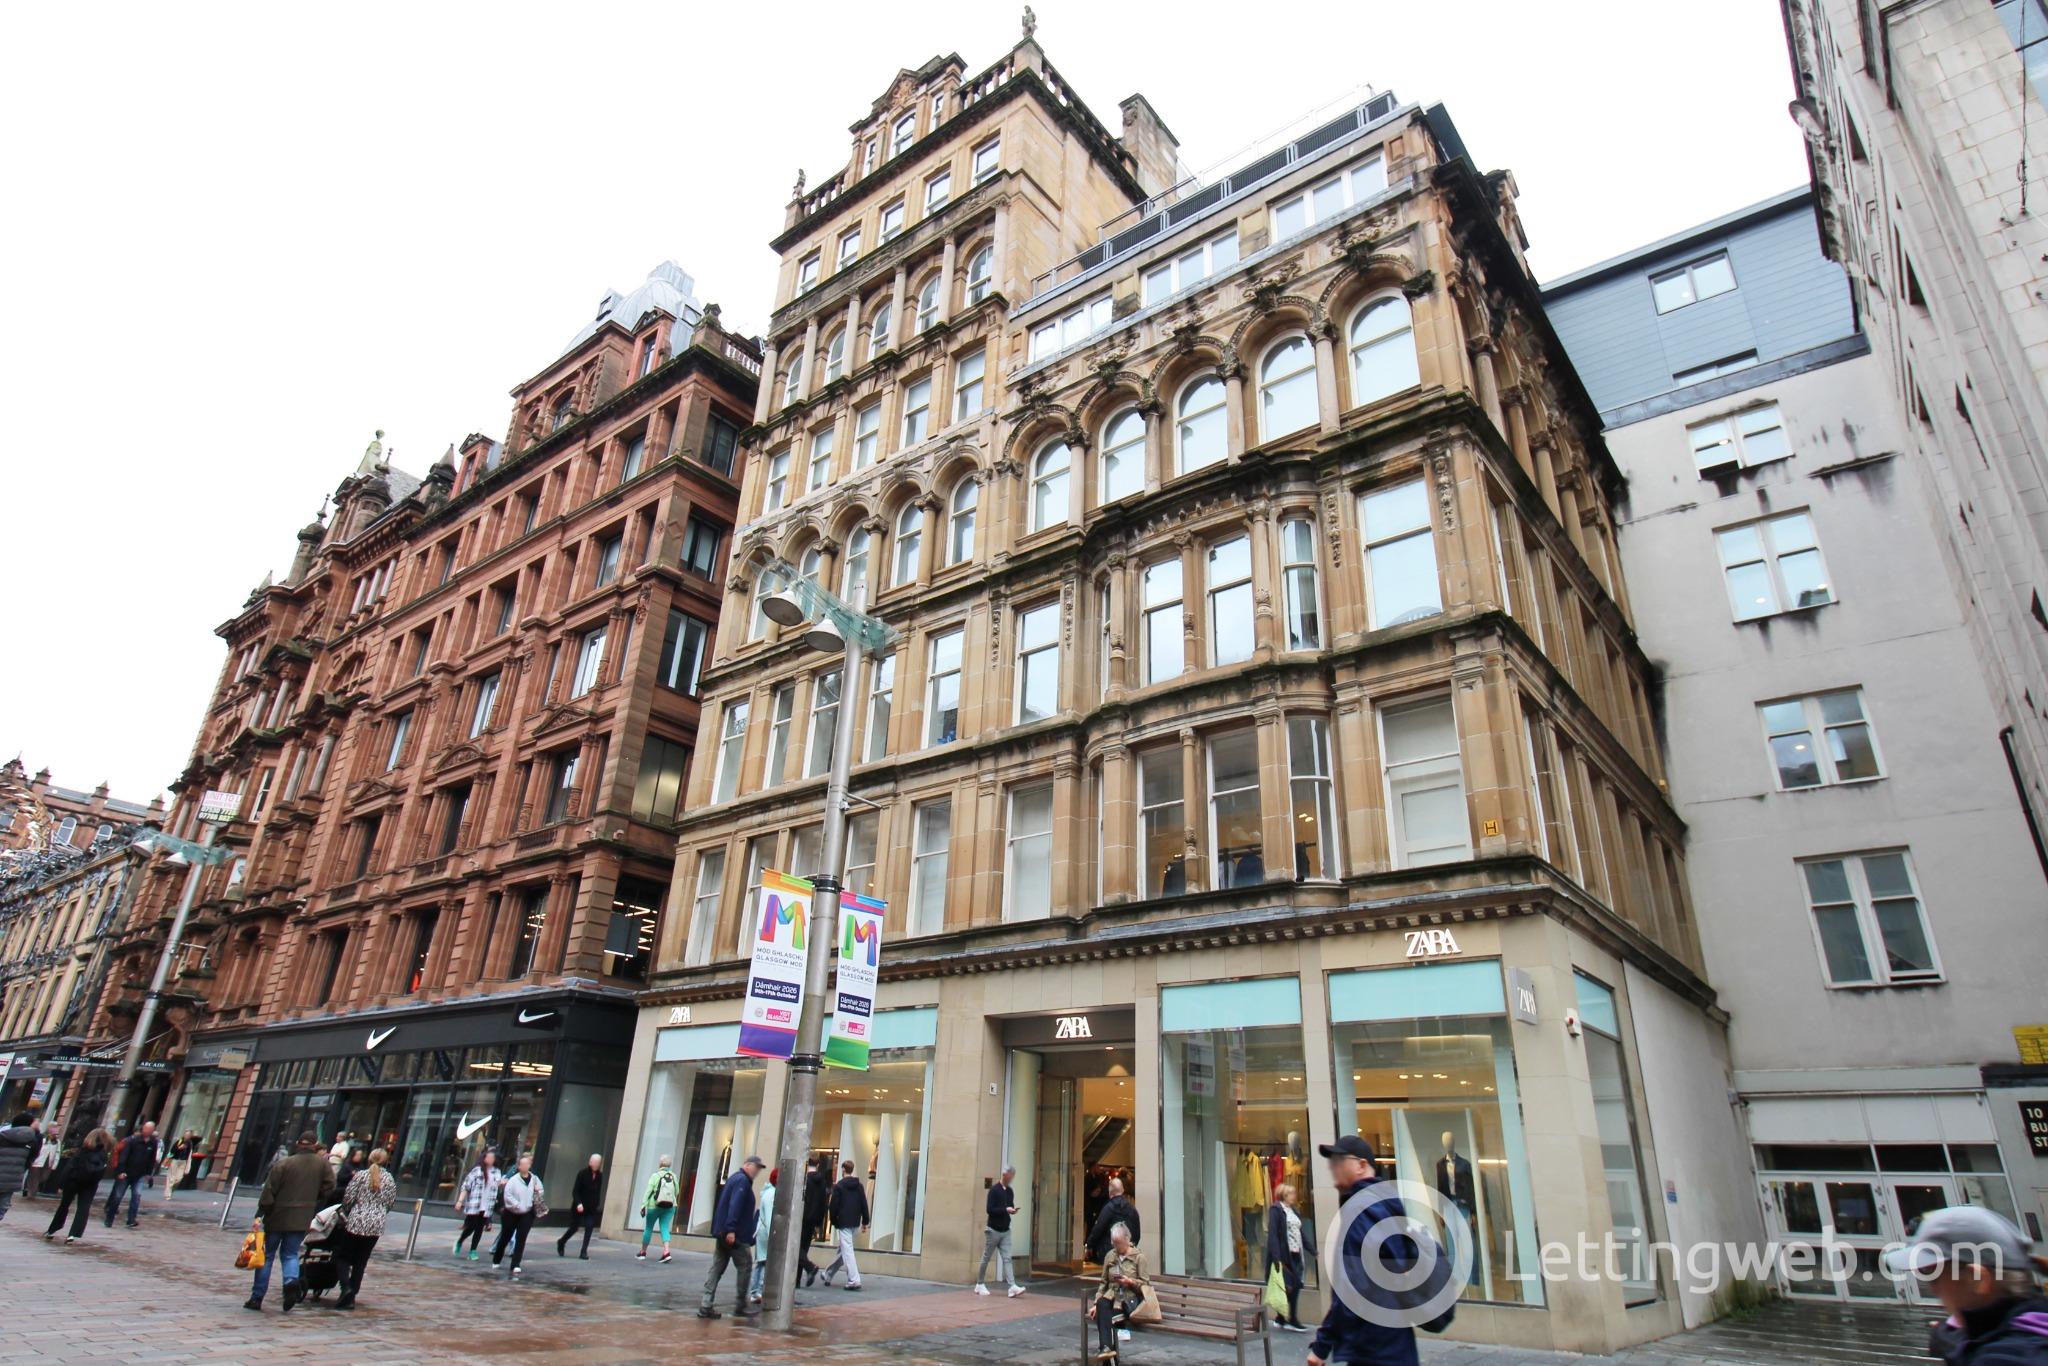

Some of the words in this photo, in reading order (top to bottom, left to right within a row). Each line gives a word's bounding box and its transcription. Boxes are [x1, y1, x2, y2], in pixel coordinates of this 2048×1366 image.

[1404, 928, 1462, 957] ZARA
[755, 954, 788, 965] GLASGOW
[789, 960, 803, 968] MOD
[781, 985, 798, 994] 2026
[776, 992, 797, 1000] October
[669, 1005, 691, 1023] ZARA
[1056, 1016, 1093, 1039] ZARA
[140, 1061, 165, 1069] ARCADE
[2026, 1108, 2043, 1119] 10
